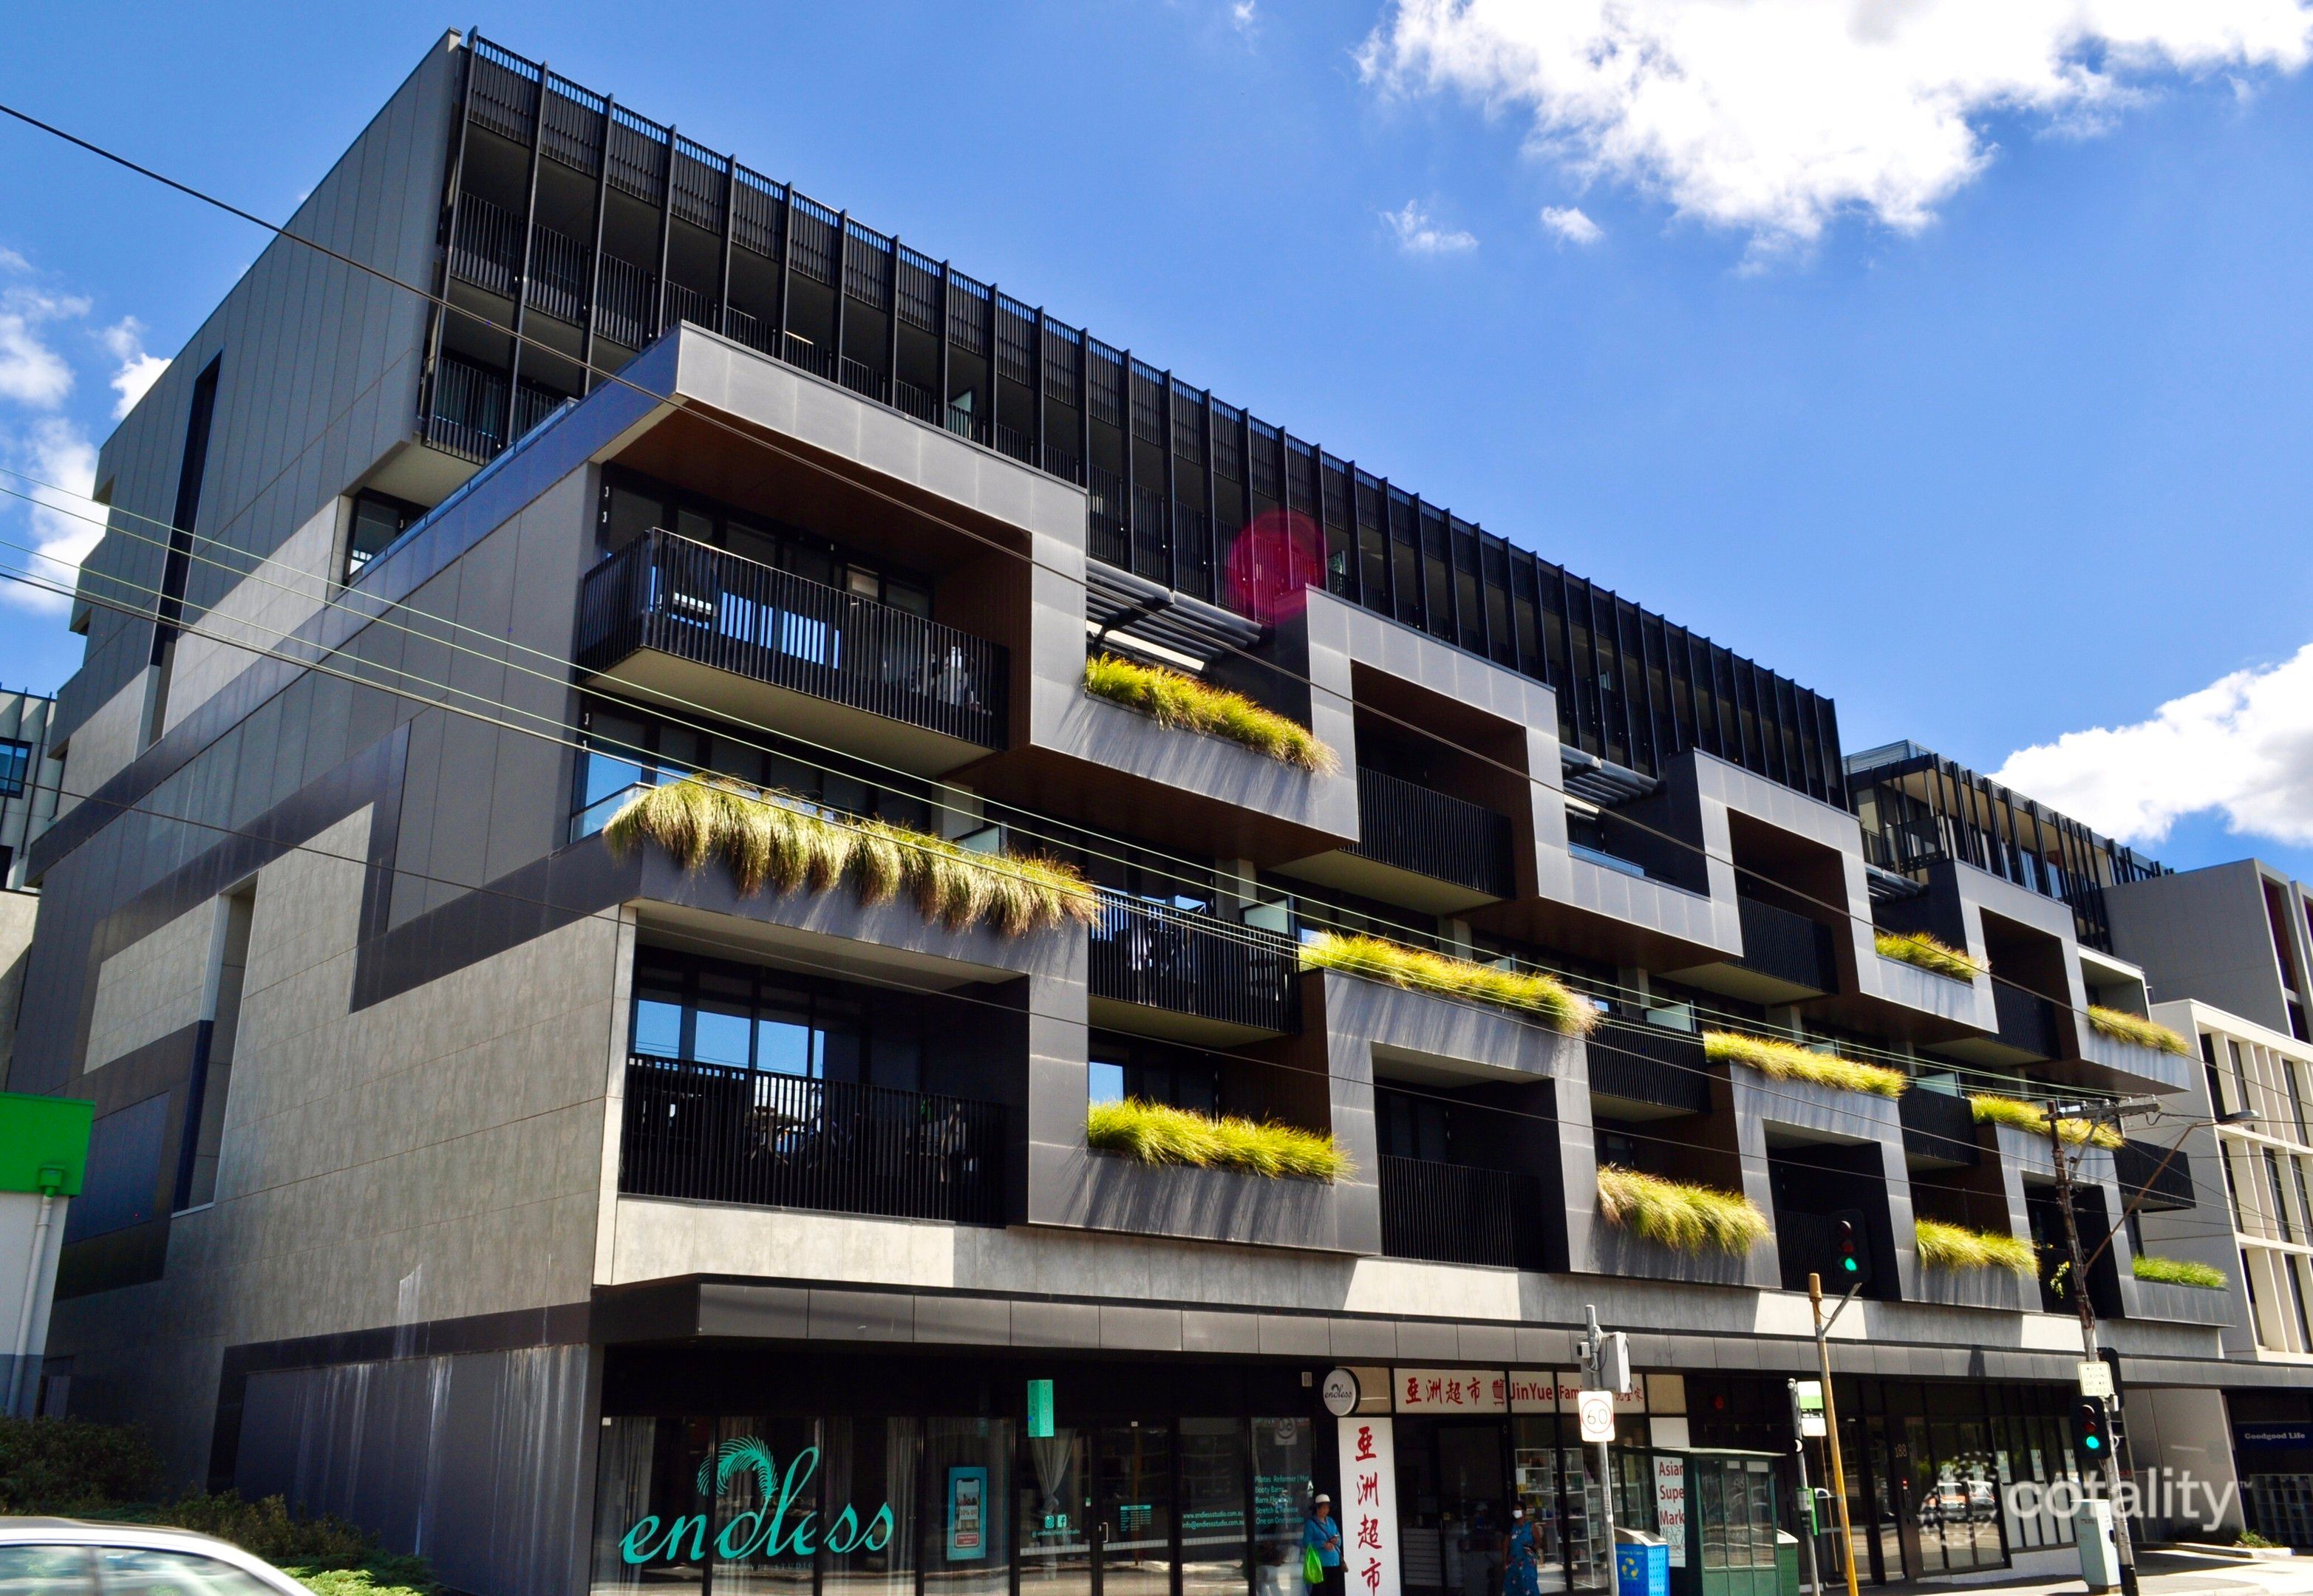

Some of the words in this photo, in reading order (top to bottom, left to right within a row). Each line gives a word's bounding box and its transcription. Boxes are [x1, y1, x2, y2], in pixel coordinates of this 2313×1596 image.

[1324, 1384, 1352, 1399] endless
[1510, 1382, 1553, 1400] JinYue
[1559, 1385, 1583, 1399] Fam
[1587, 1409, 1608, 1425] 60
[619, 1435, 894, 1563] endless
